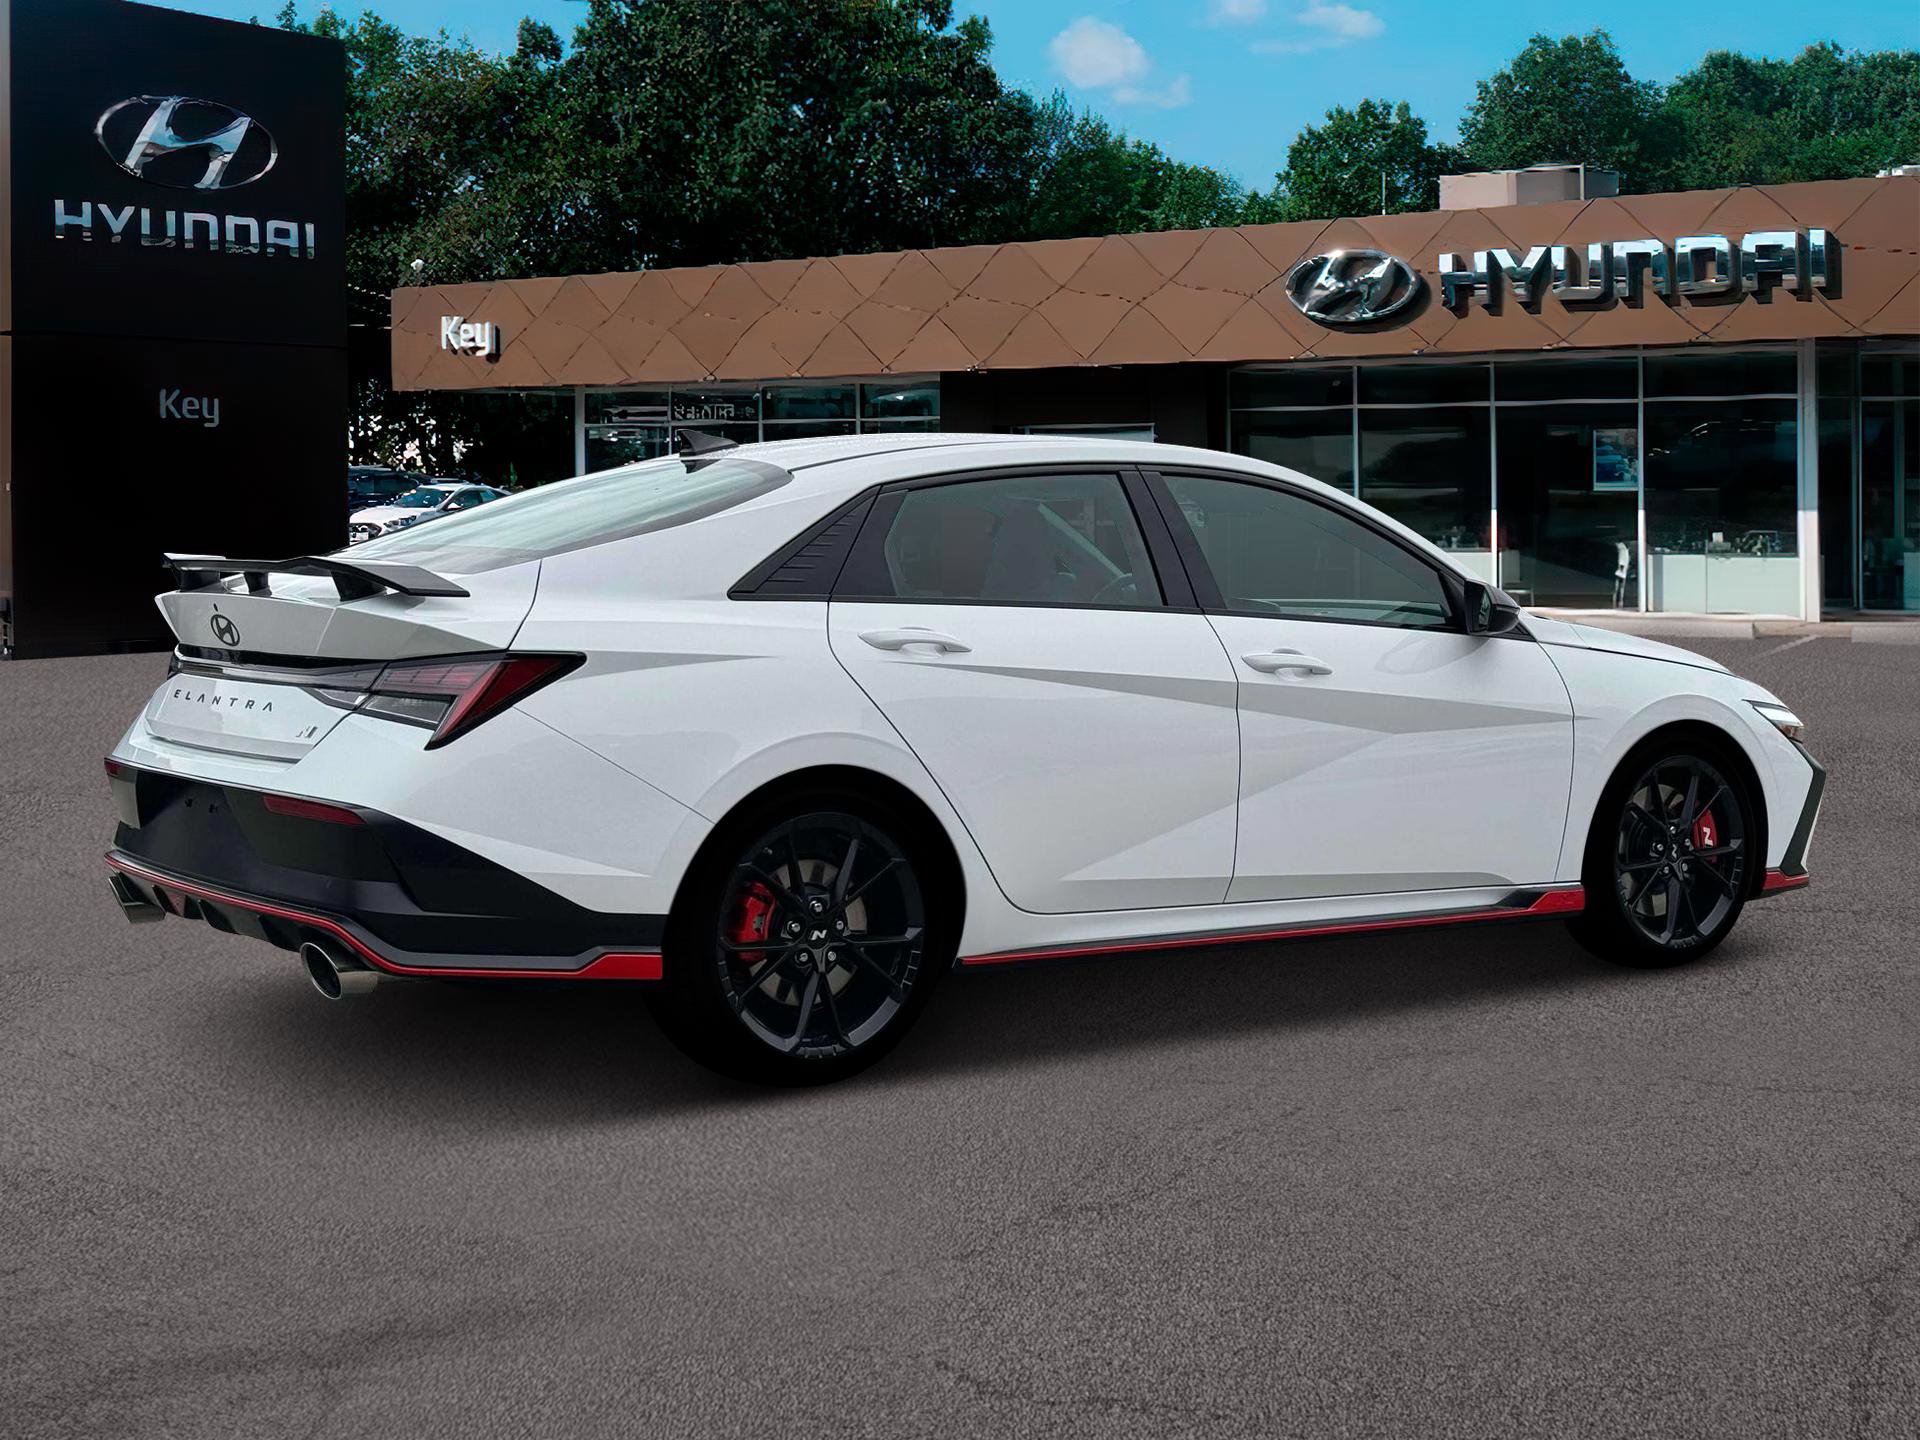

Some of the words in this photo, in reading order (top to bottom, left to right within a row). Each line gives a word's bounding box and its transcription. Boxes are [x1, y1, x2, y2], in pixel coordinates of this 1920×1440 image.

[54, 199, 315, 259] HYUNDAI
[1438, 228, 1833, 312] HYUNDAI
[440, 315, 493, 357] Key
[159, 388, 220, 428] Key
[173, 689, 274, 712] ELANTRA
[811, 929, 828, 941] N
